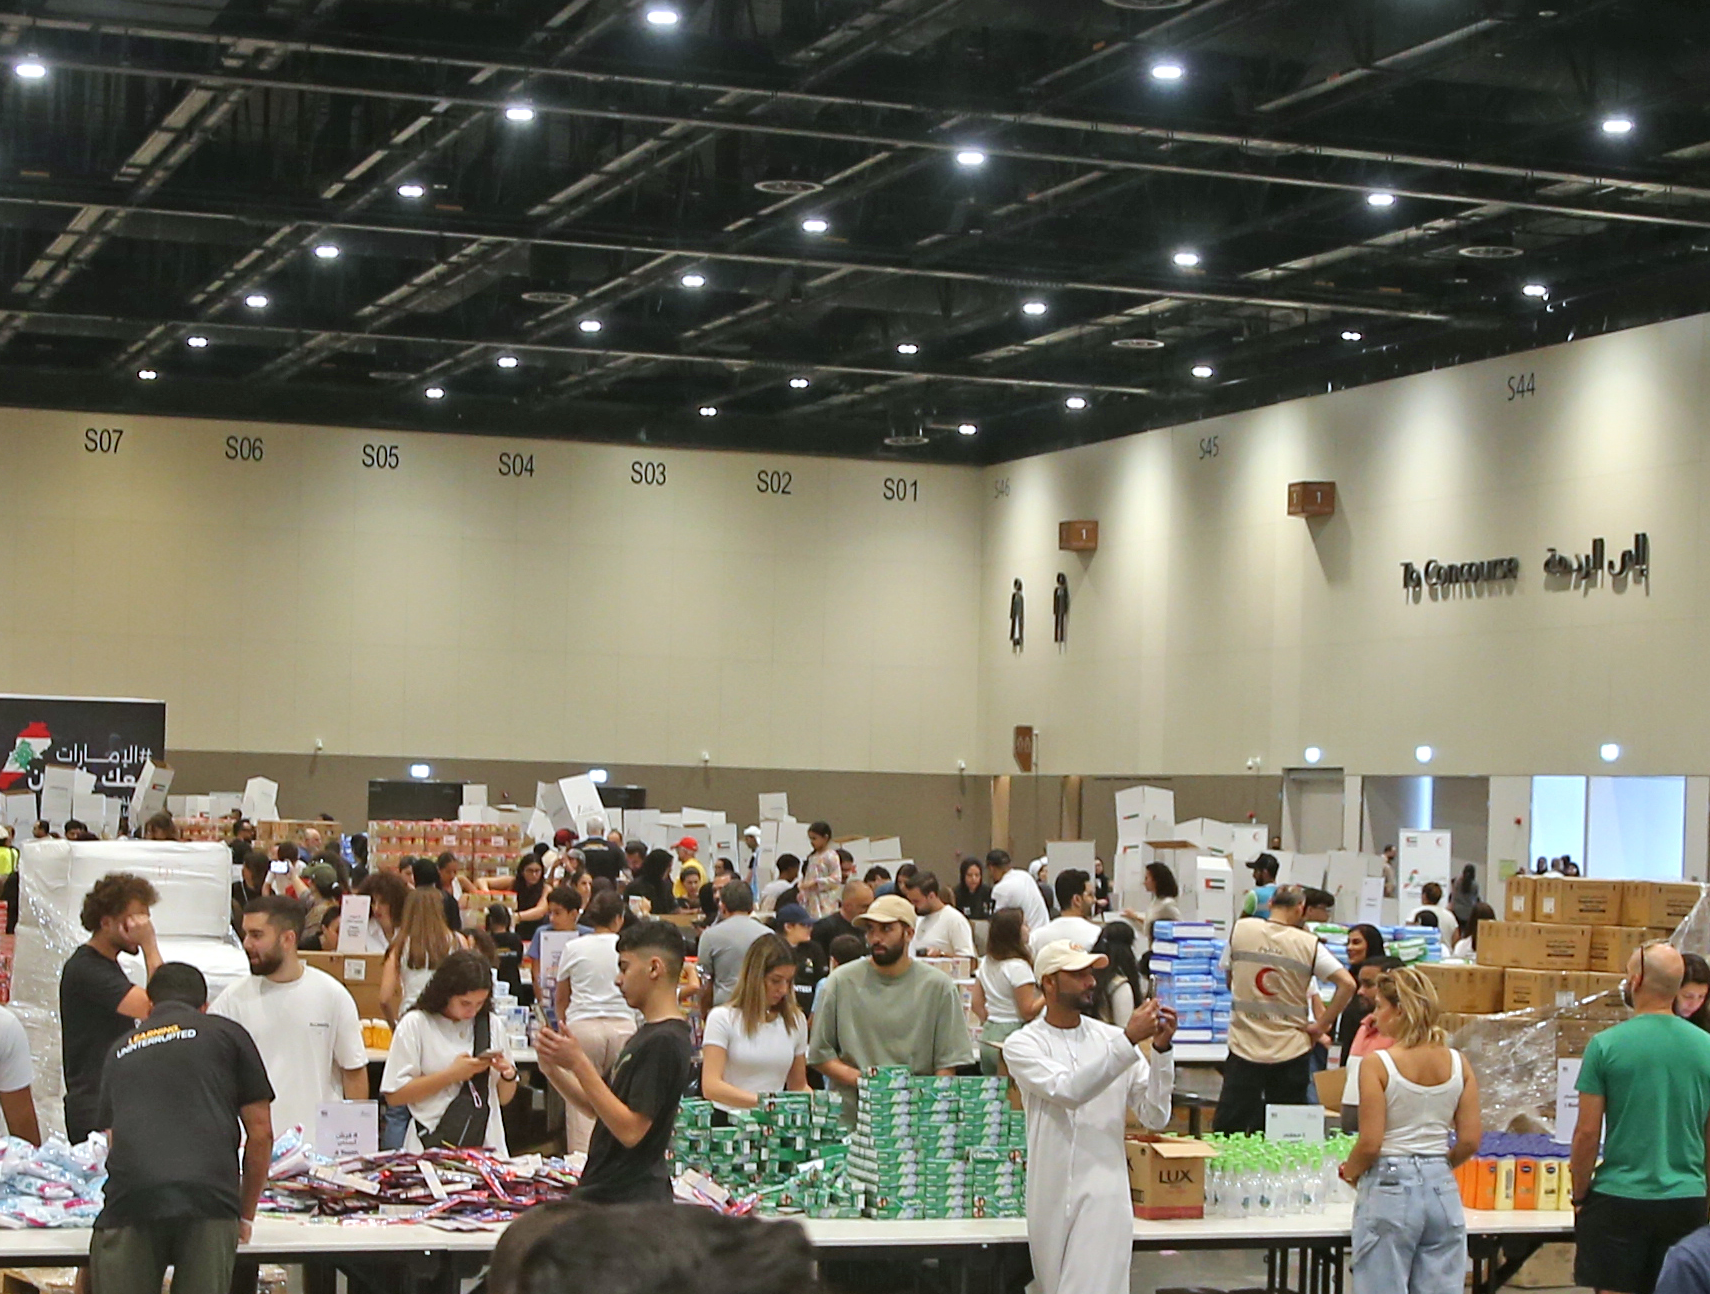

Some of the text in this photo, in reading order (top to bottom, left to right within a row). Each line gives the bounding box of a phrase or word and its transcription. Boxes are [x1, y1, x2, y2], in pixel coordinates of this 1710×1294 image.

[1506, 373, 1537, 400] S44
[83, 427, 124, 454] S07
[224, 435, 264, 462] S06
[1198, 435, 1220, 461] S45
[361, 443, 400, 470] S05
[497, 452, 536, 479] S04
[629, 460, 667, 487] S03
[756, 469, 793, 496] S02
[882, 476, 920, 503] S01
[1399, 557, 1520, 588] To Concourse
[101, 766, 140, 789] عك
[116, 1028, 197, 1059] UNINTERRUPTED
[1158, 1169, 1194, 1184] LUX
